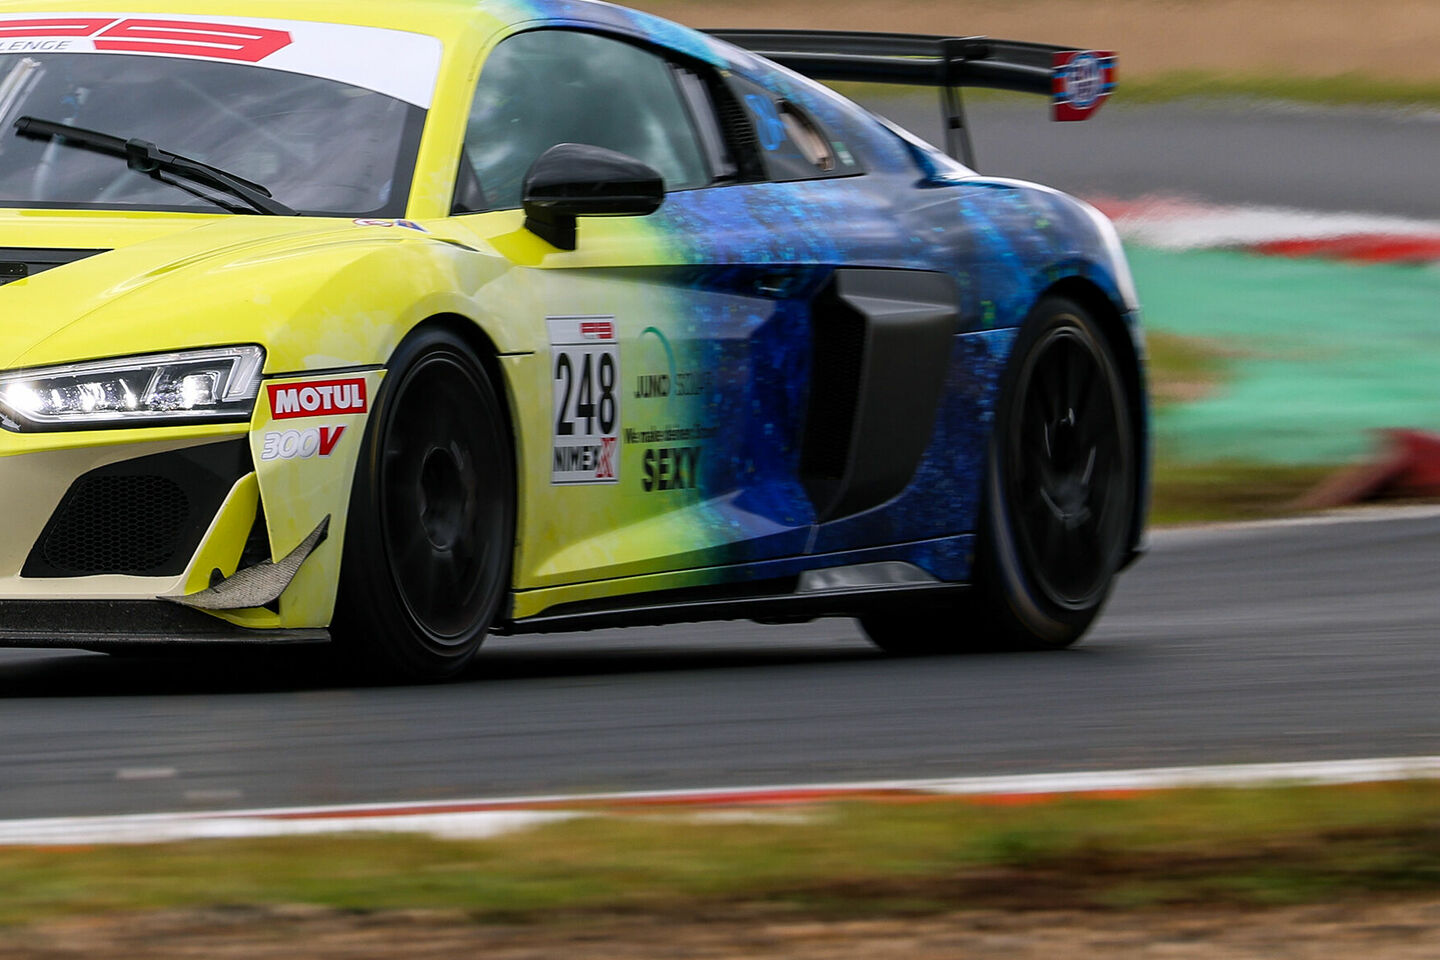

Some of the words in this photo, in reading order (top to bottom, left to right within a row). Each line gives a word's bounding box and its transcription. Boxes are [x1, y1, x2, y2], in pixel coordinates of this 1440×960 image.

[275, 384, 364, 414] MOTUL
[555, 352, 616, 436] 248
[261, 425, 347, 460] 300V
[641, 446, 702, 492] SEXY
